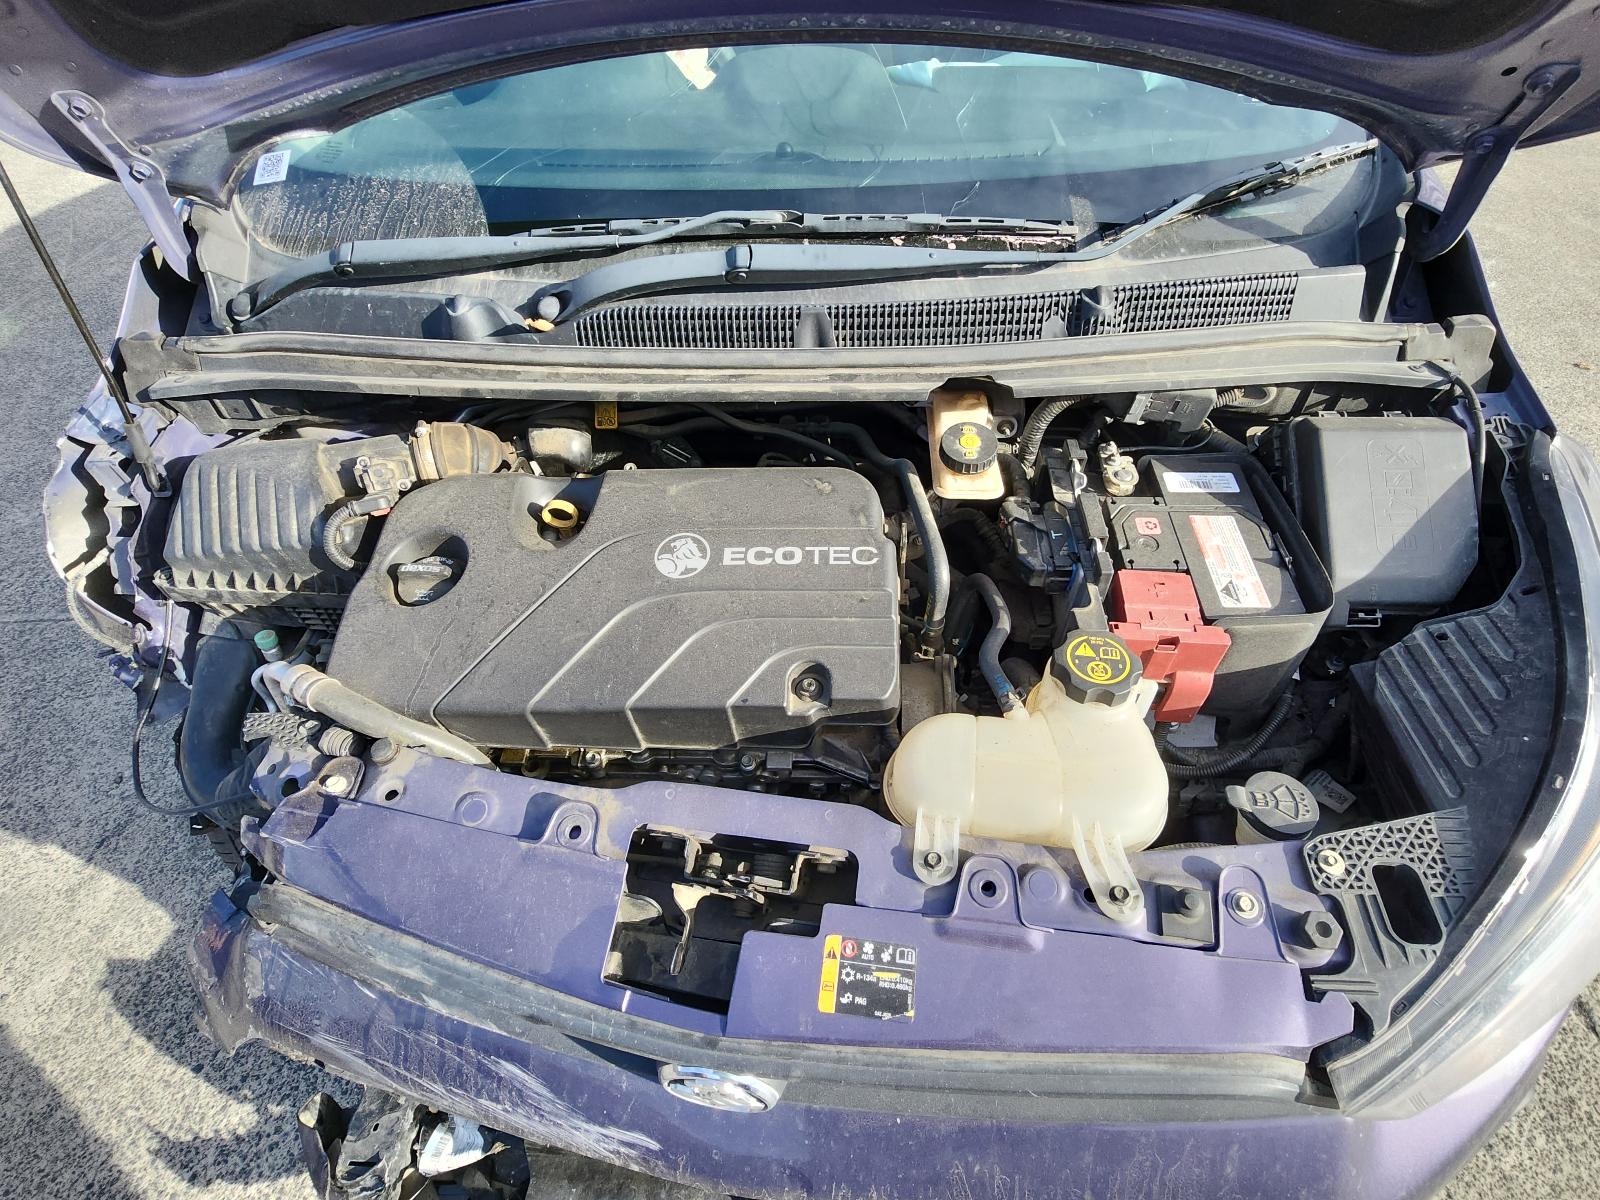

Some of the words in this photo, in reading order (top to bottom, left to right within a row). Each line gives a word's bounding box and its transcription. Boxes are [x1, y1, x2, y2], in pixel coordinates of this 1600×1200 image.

[722, 546, 880, 566] ECOTEC
[401, 563, 440, 573] dexos
[856, 972, 877, 983] R-134a
[854, 996, 867, 1006] PAG
